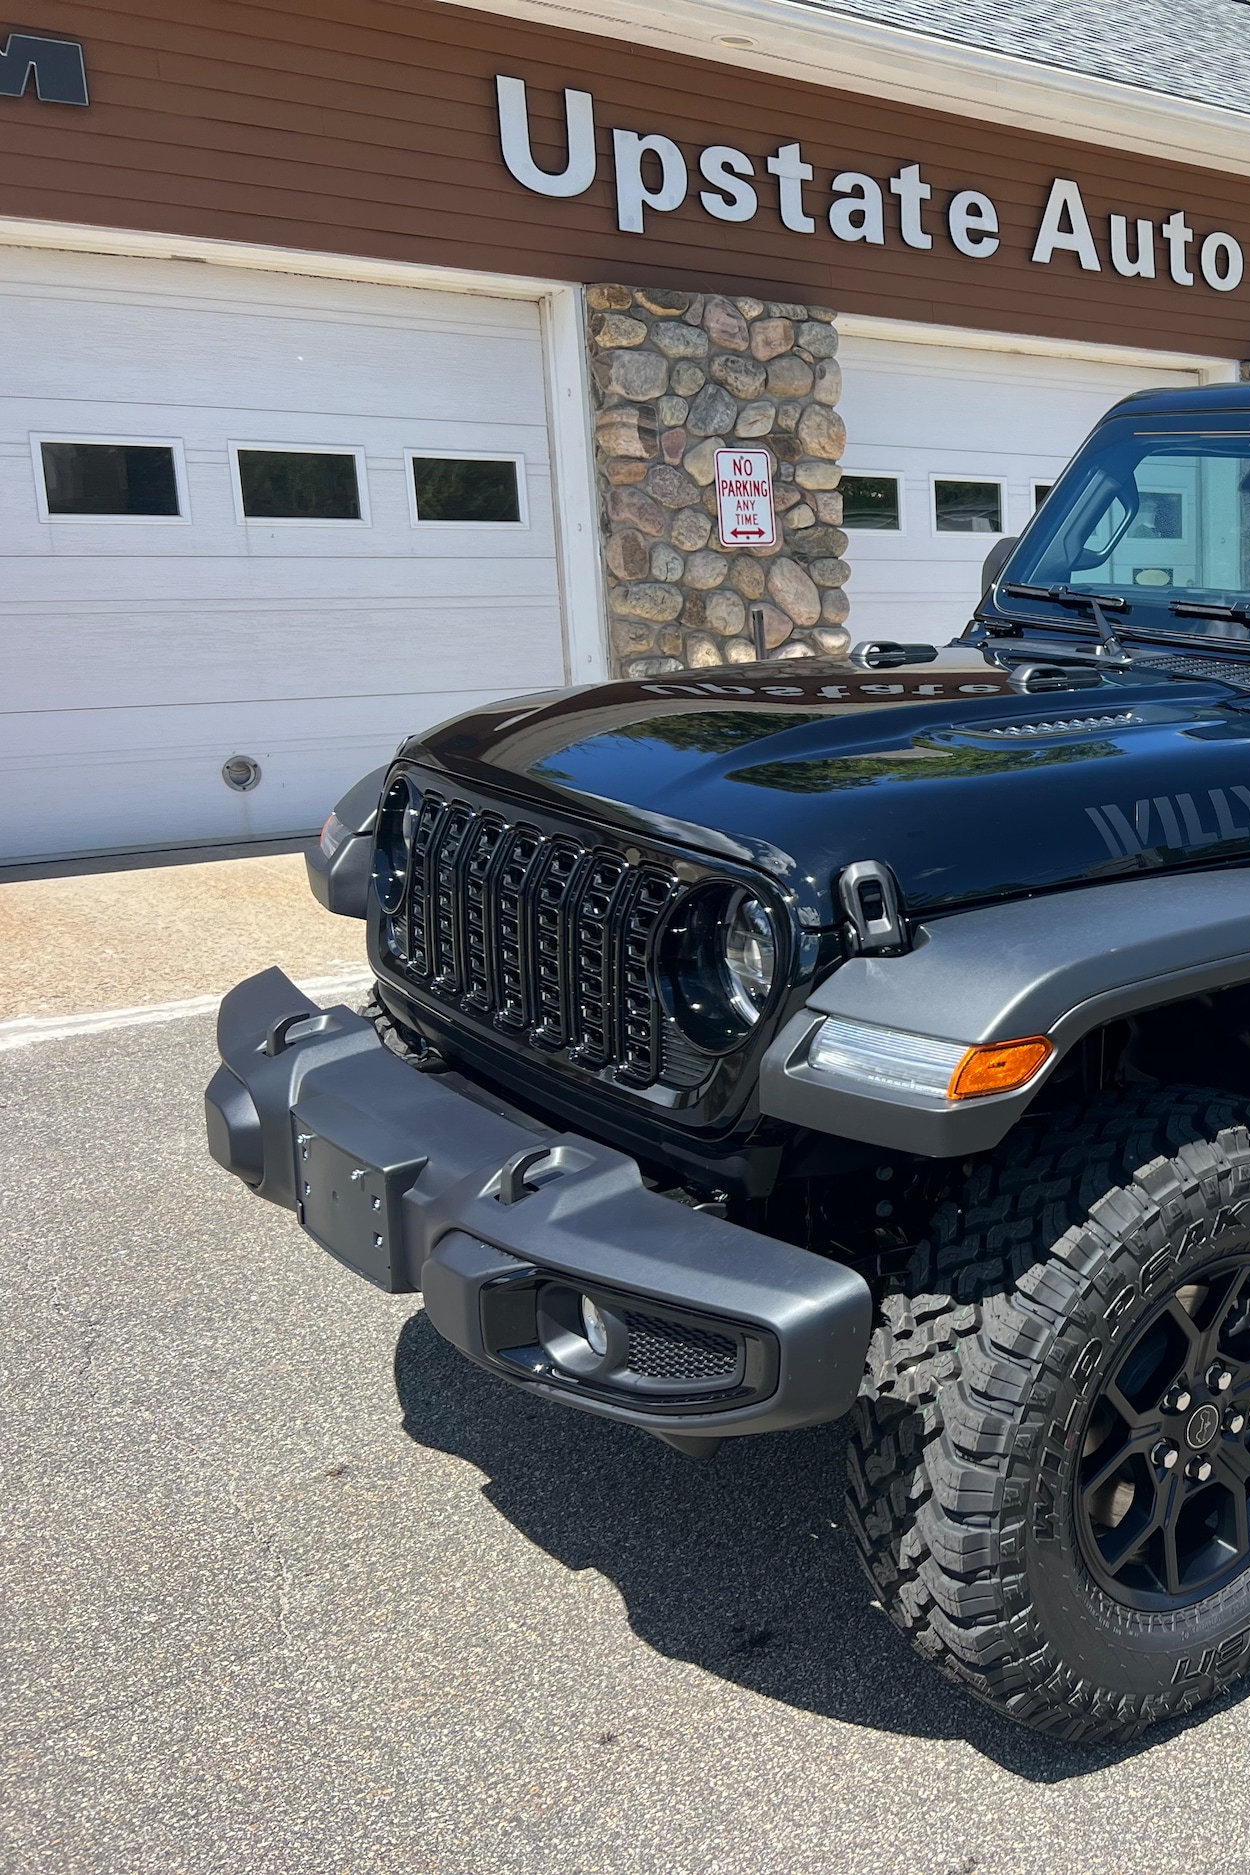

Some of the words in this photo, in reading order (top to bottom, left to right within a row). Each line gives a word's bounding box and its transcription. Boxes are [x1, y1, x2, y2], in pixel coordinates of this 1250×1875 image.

[495, 74, 1001, 259] Upstate
[1031, 177, 1245, 292] Auto
[733, 459, 753, 476] NO
[721, 480, 768, 497] PARKING
[736, 500, 756, 511] ANY
[735, 513, 759, 526] TIME
